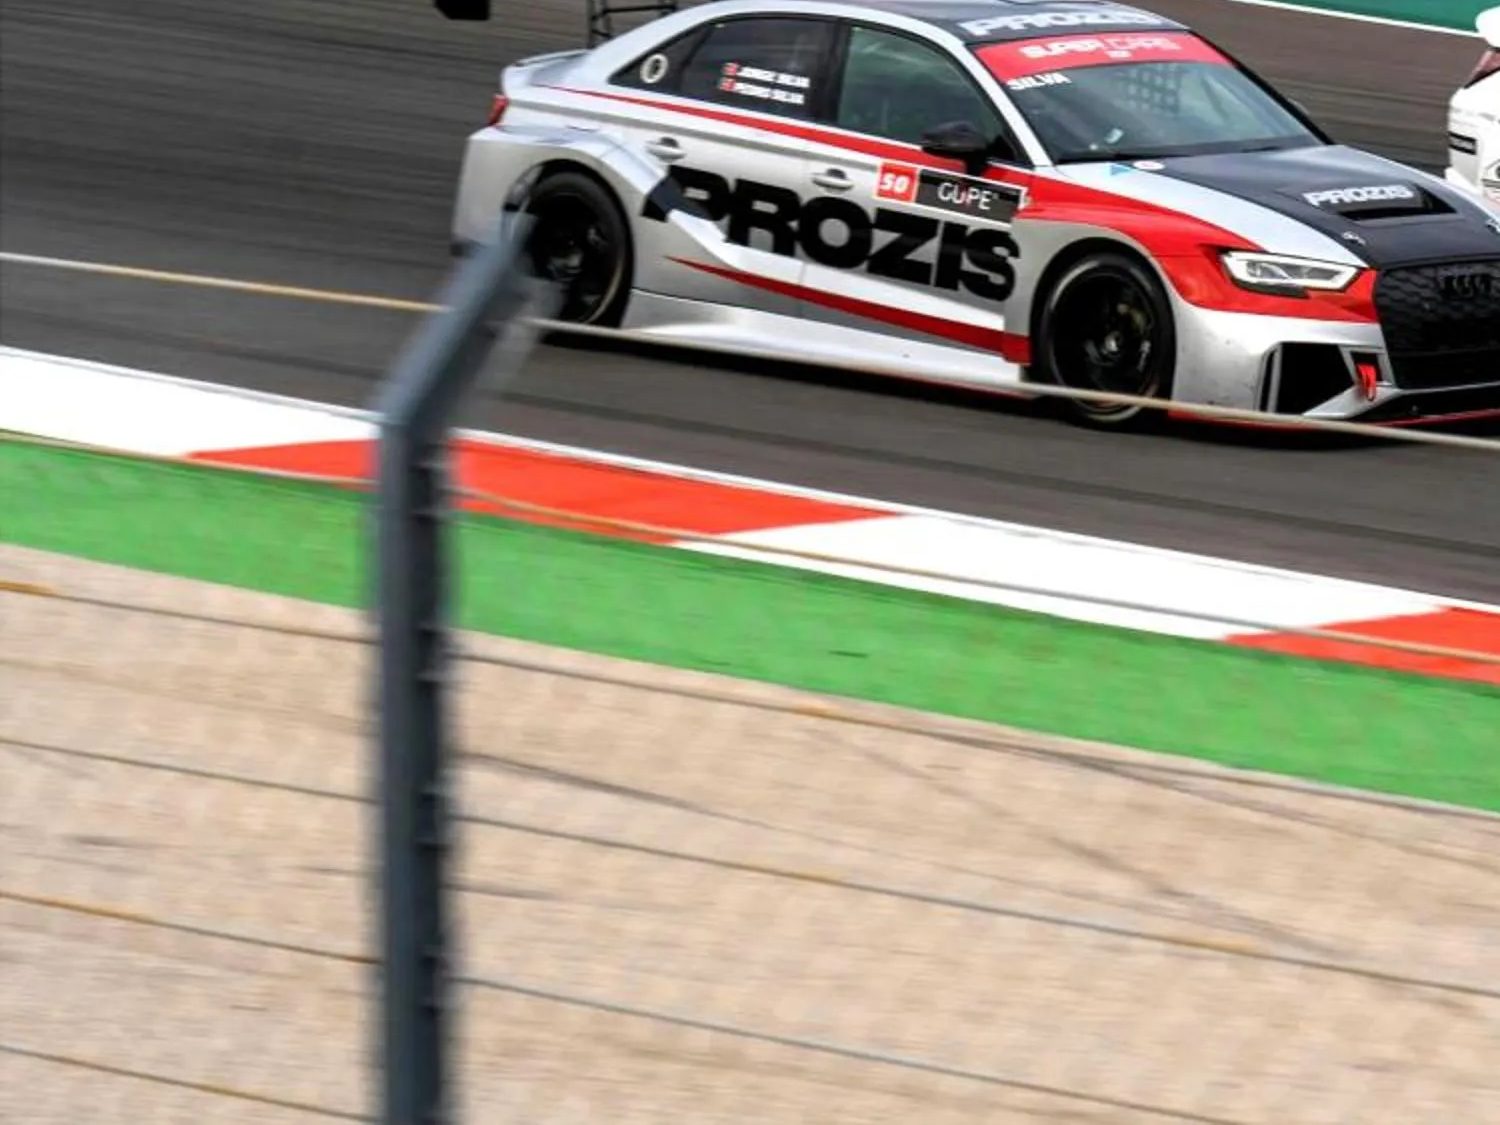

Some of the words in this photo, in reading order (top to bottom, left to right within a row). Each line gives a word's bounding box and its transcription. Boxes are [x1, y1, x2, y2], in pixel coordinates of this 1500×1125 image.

[1005, 72, 1072, 92] SILVA
[879, 172, 912, 195] 50
[1302, 184, 1415, 207] PROZIS
[641, 164, 1021, 302] PROZIS
